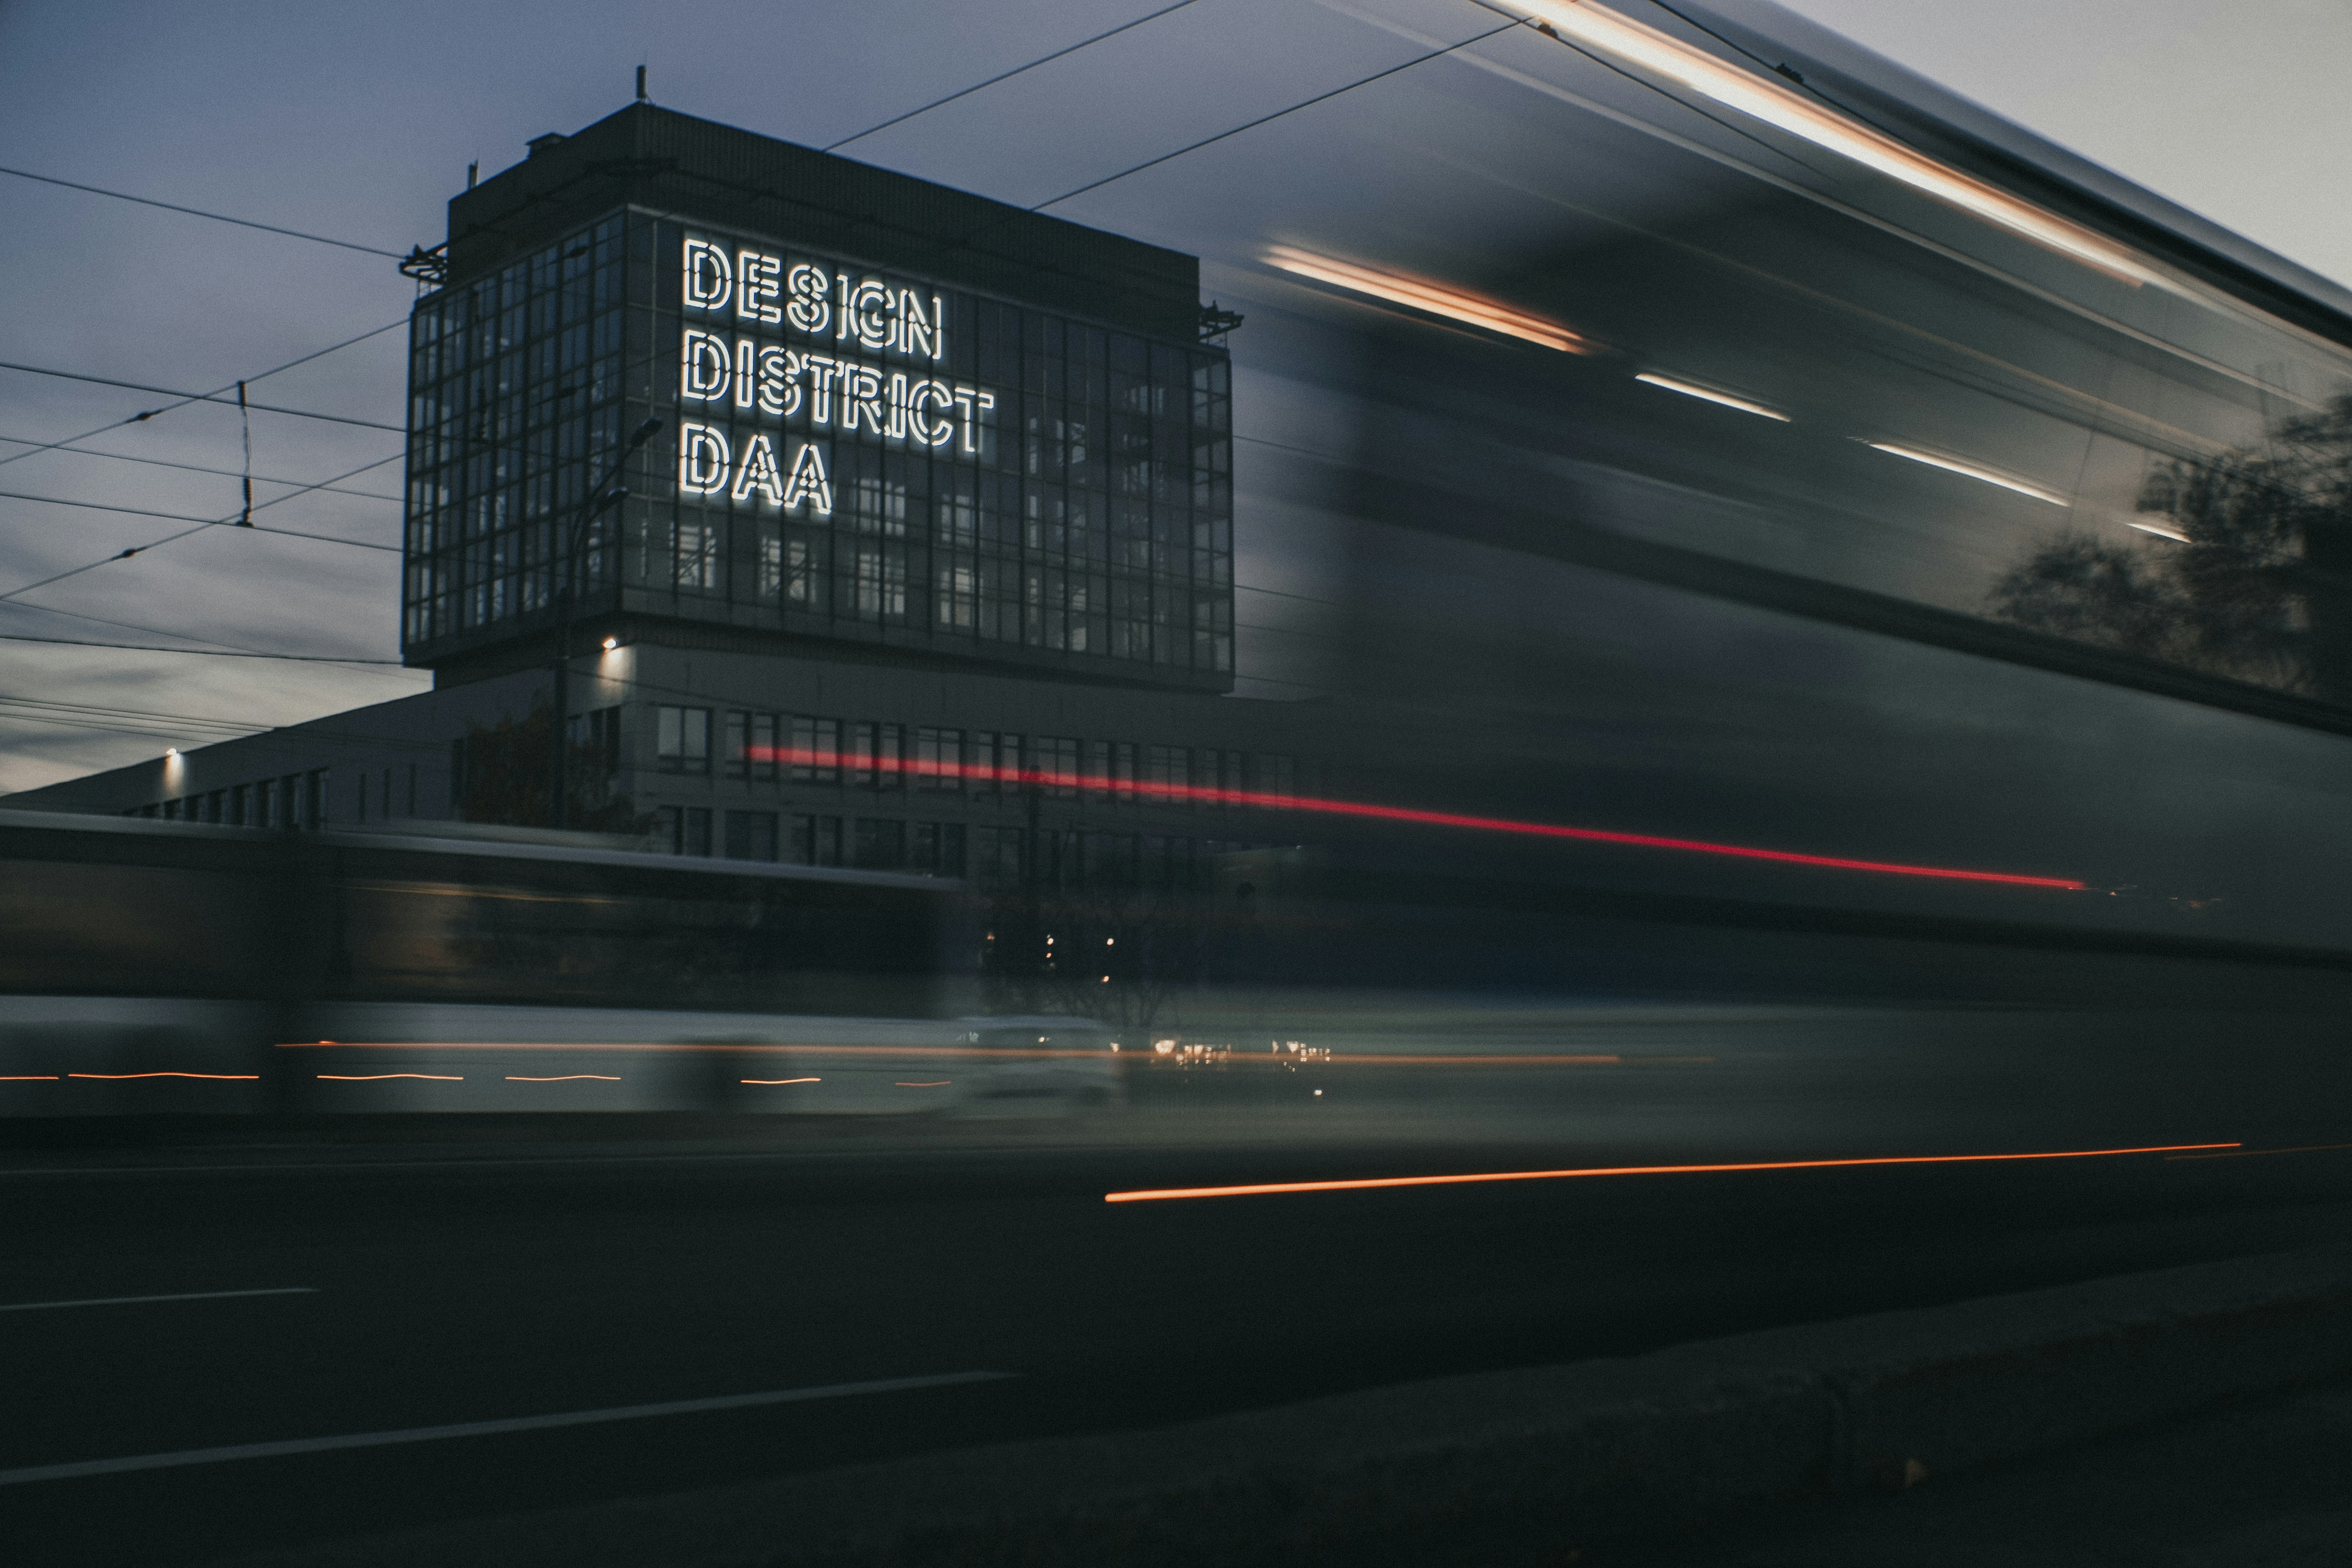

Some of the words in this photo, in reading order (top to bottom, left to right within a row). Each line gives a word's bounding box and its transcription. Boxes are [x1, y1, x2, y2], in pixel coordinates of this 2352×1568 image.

[683, 238, 942, 360] DESIGN
[681, 329, 995, 453] DISTRICT
[680, 422, 832, 515] DAA
